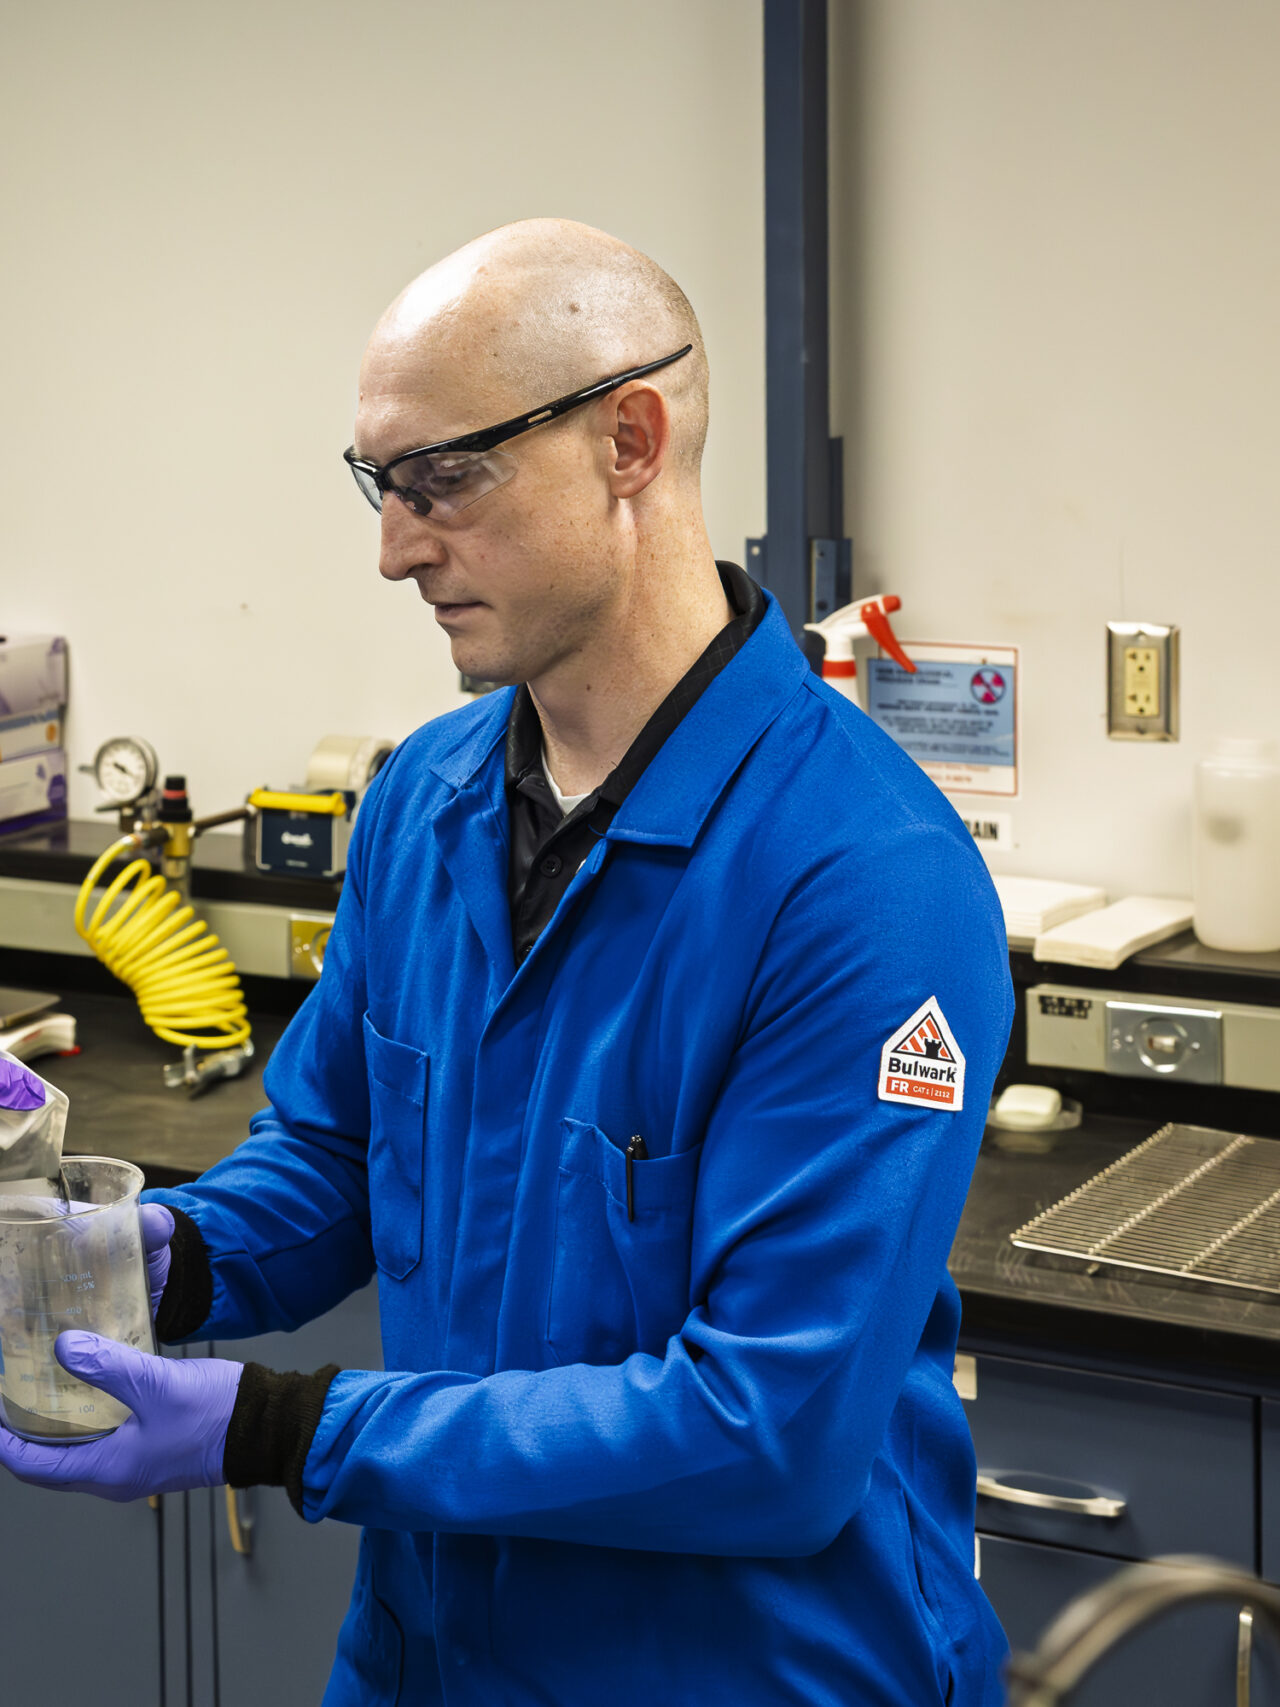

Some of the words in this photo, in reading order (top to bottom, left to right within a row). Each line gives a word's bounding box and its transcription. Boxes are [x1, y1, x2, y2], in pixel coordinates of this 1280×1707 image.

[888, 1057, 957, 1083] Bulwark
[891, 1080, 909, 1093] FR
[935, 1089, 950, 1098] 2112
[79, 1404, 95, 1413] 100
